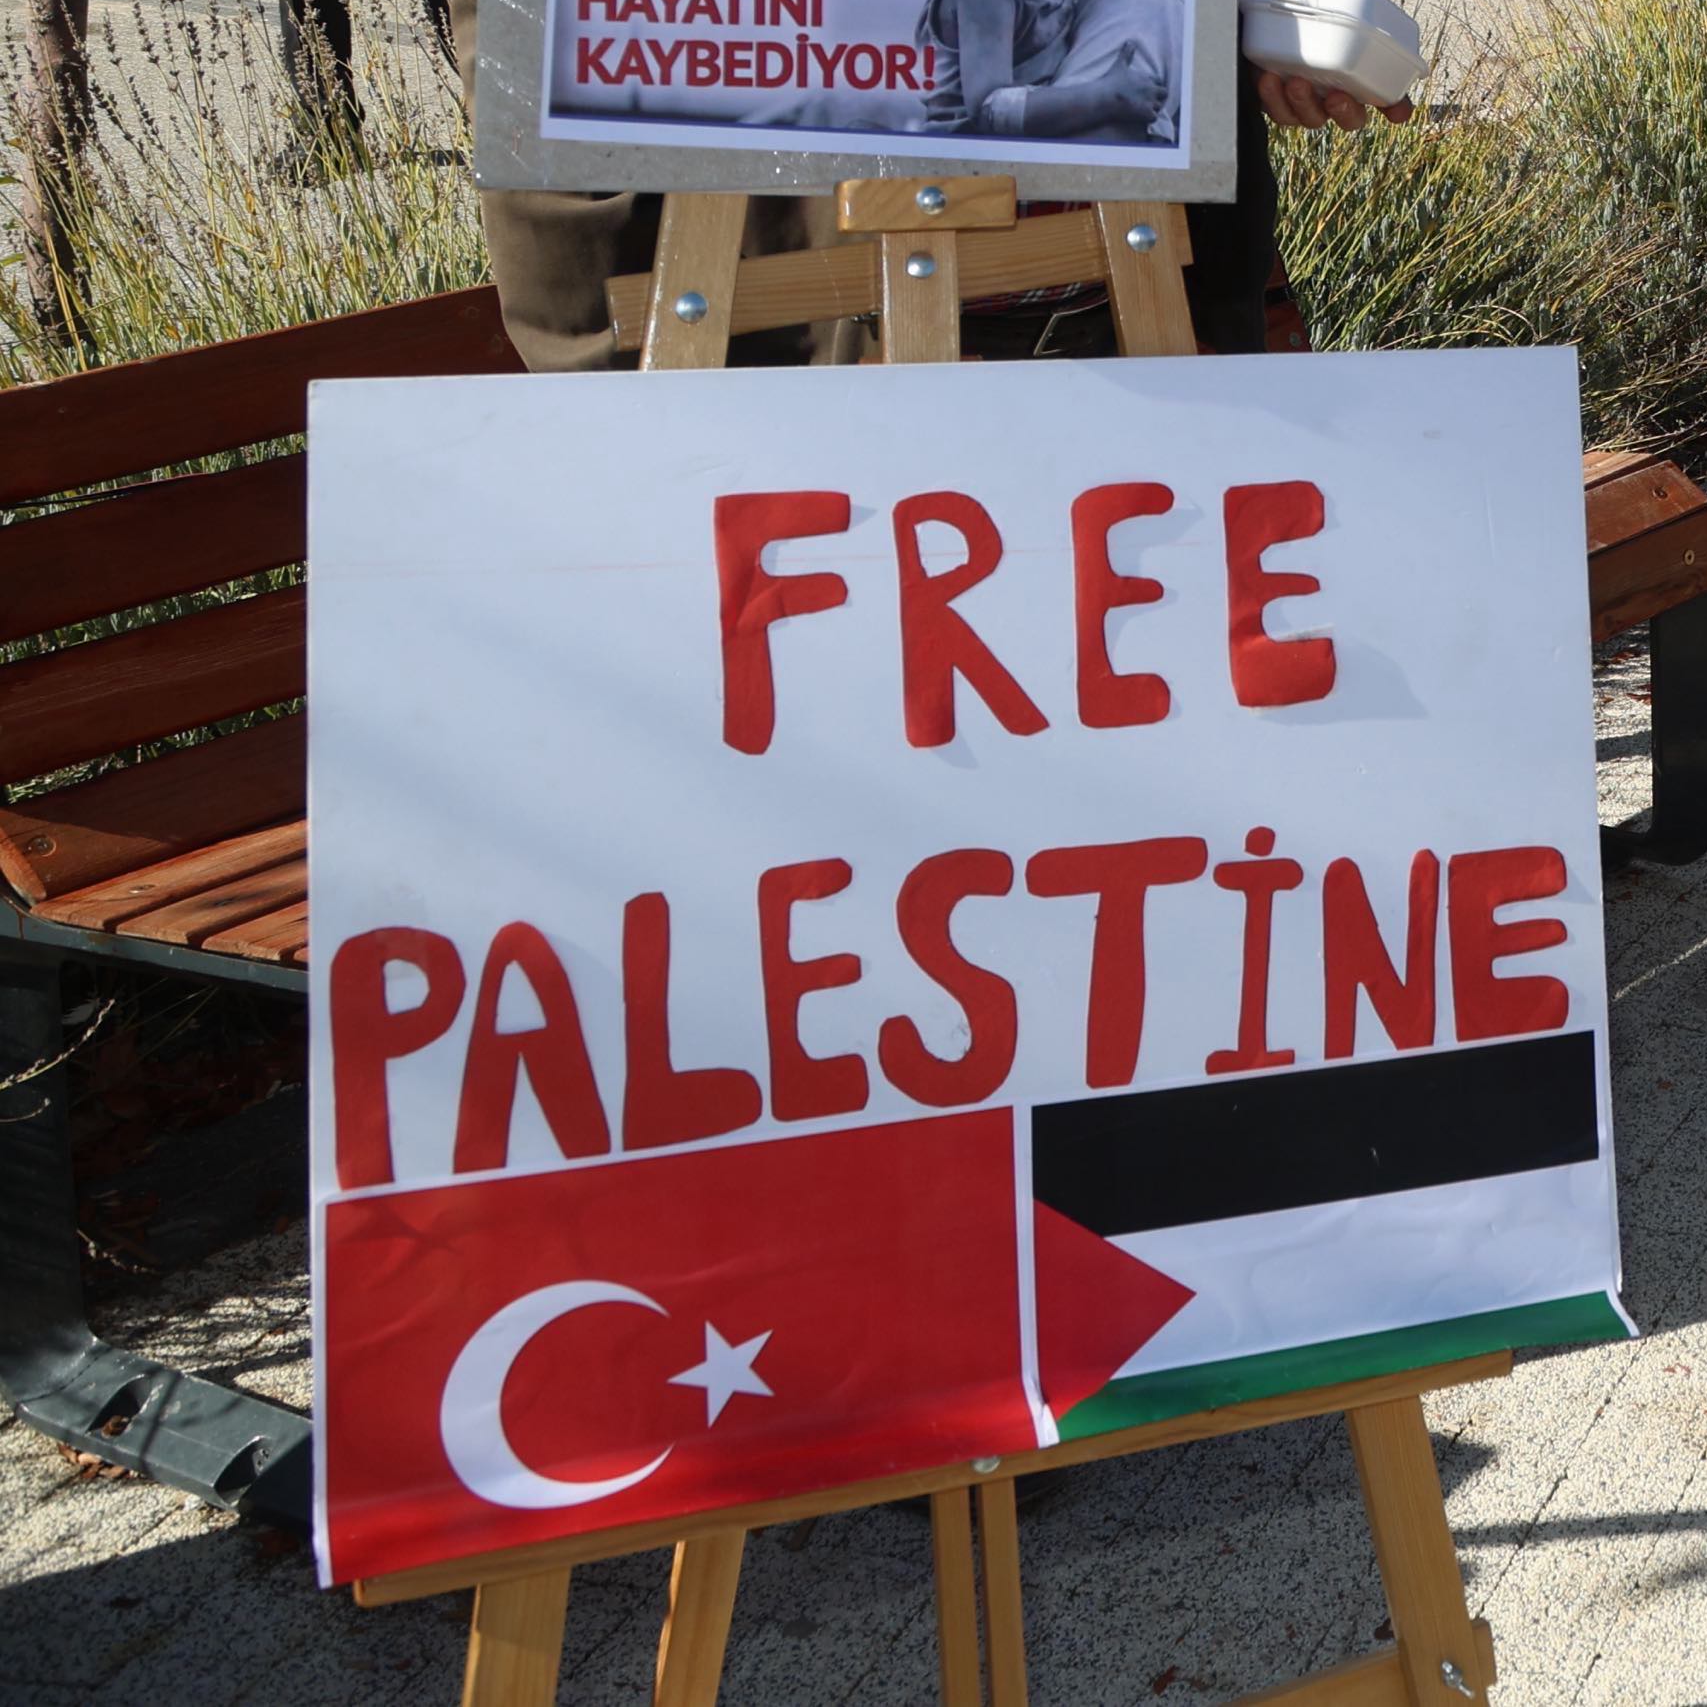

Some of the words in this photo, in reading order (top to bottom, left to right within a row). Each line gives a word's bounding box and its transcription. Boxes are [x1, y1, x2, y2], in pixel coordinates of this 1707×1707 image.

[576, 34, 937, 91] KAYBEDİYOR!
[713, 479, 1339, 755] FREE
[329, 826, 1572, 1191] PALESTİNE
